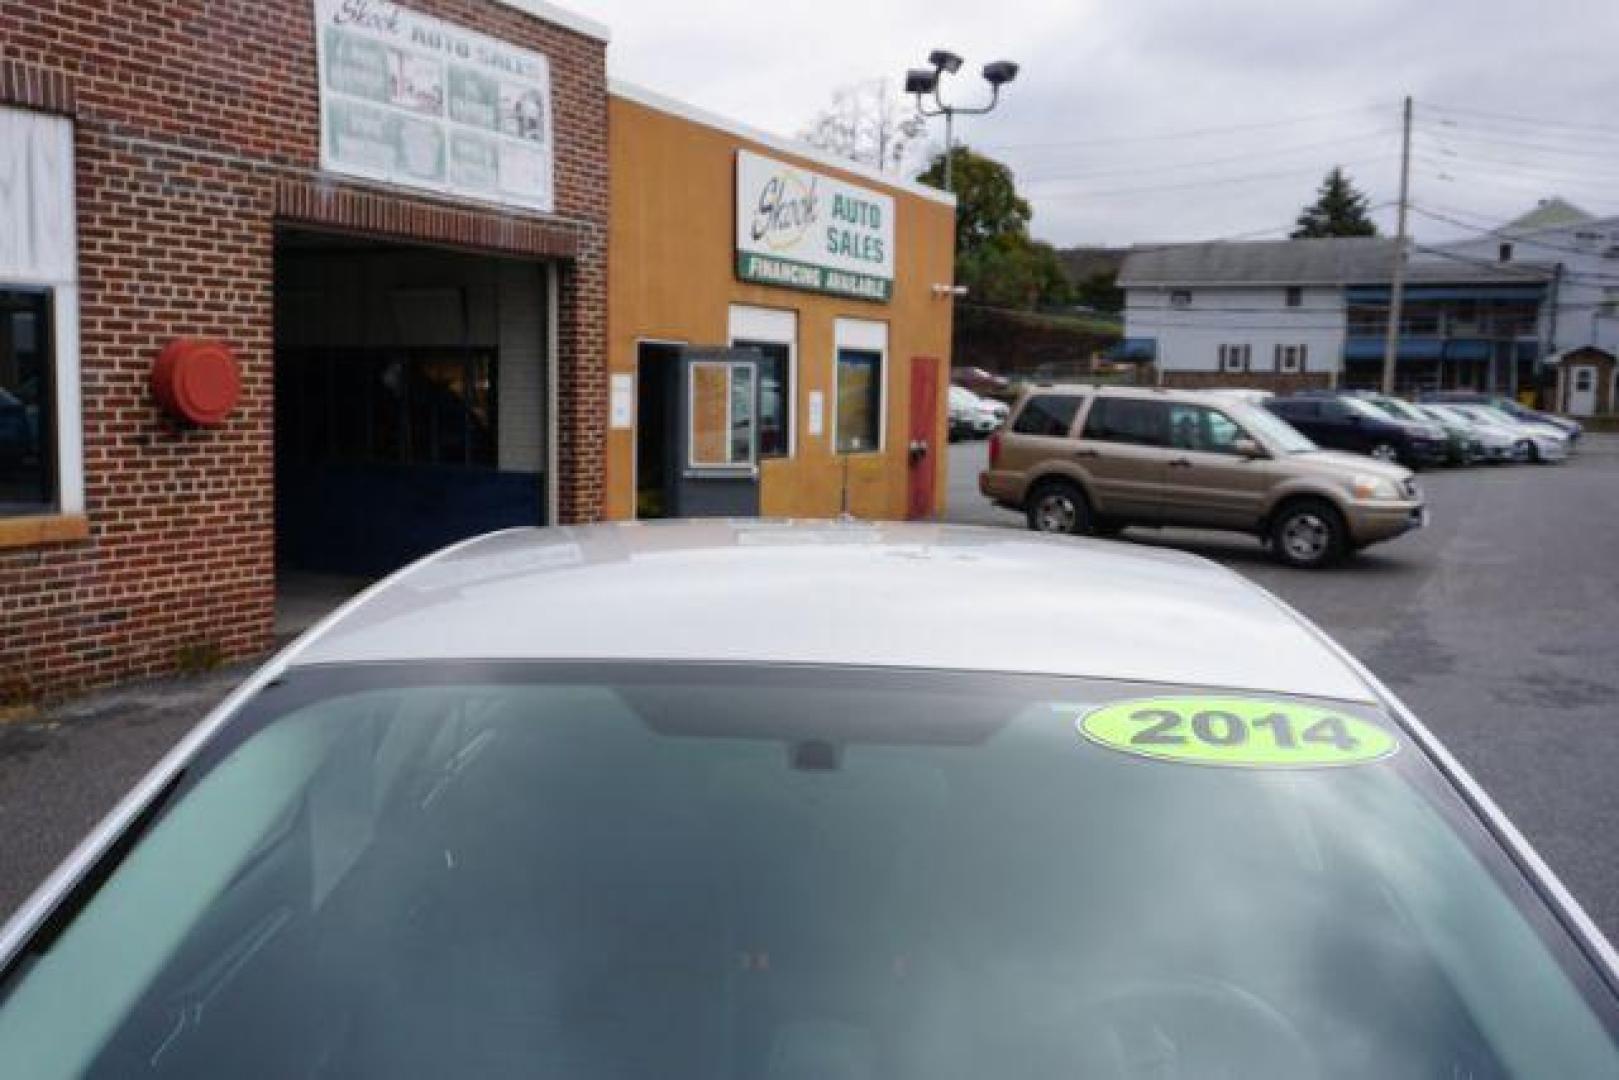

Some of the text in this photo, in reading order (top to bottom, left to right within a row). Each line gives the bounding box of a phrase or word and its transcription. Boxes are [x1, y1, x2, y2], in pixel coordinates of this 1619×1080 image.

[832, 191, 881, 228] AUTO
[827, 227, 884, 263] SALES
[1129, 709, 1359, 750] 2014
